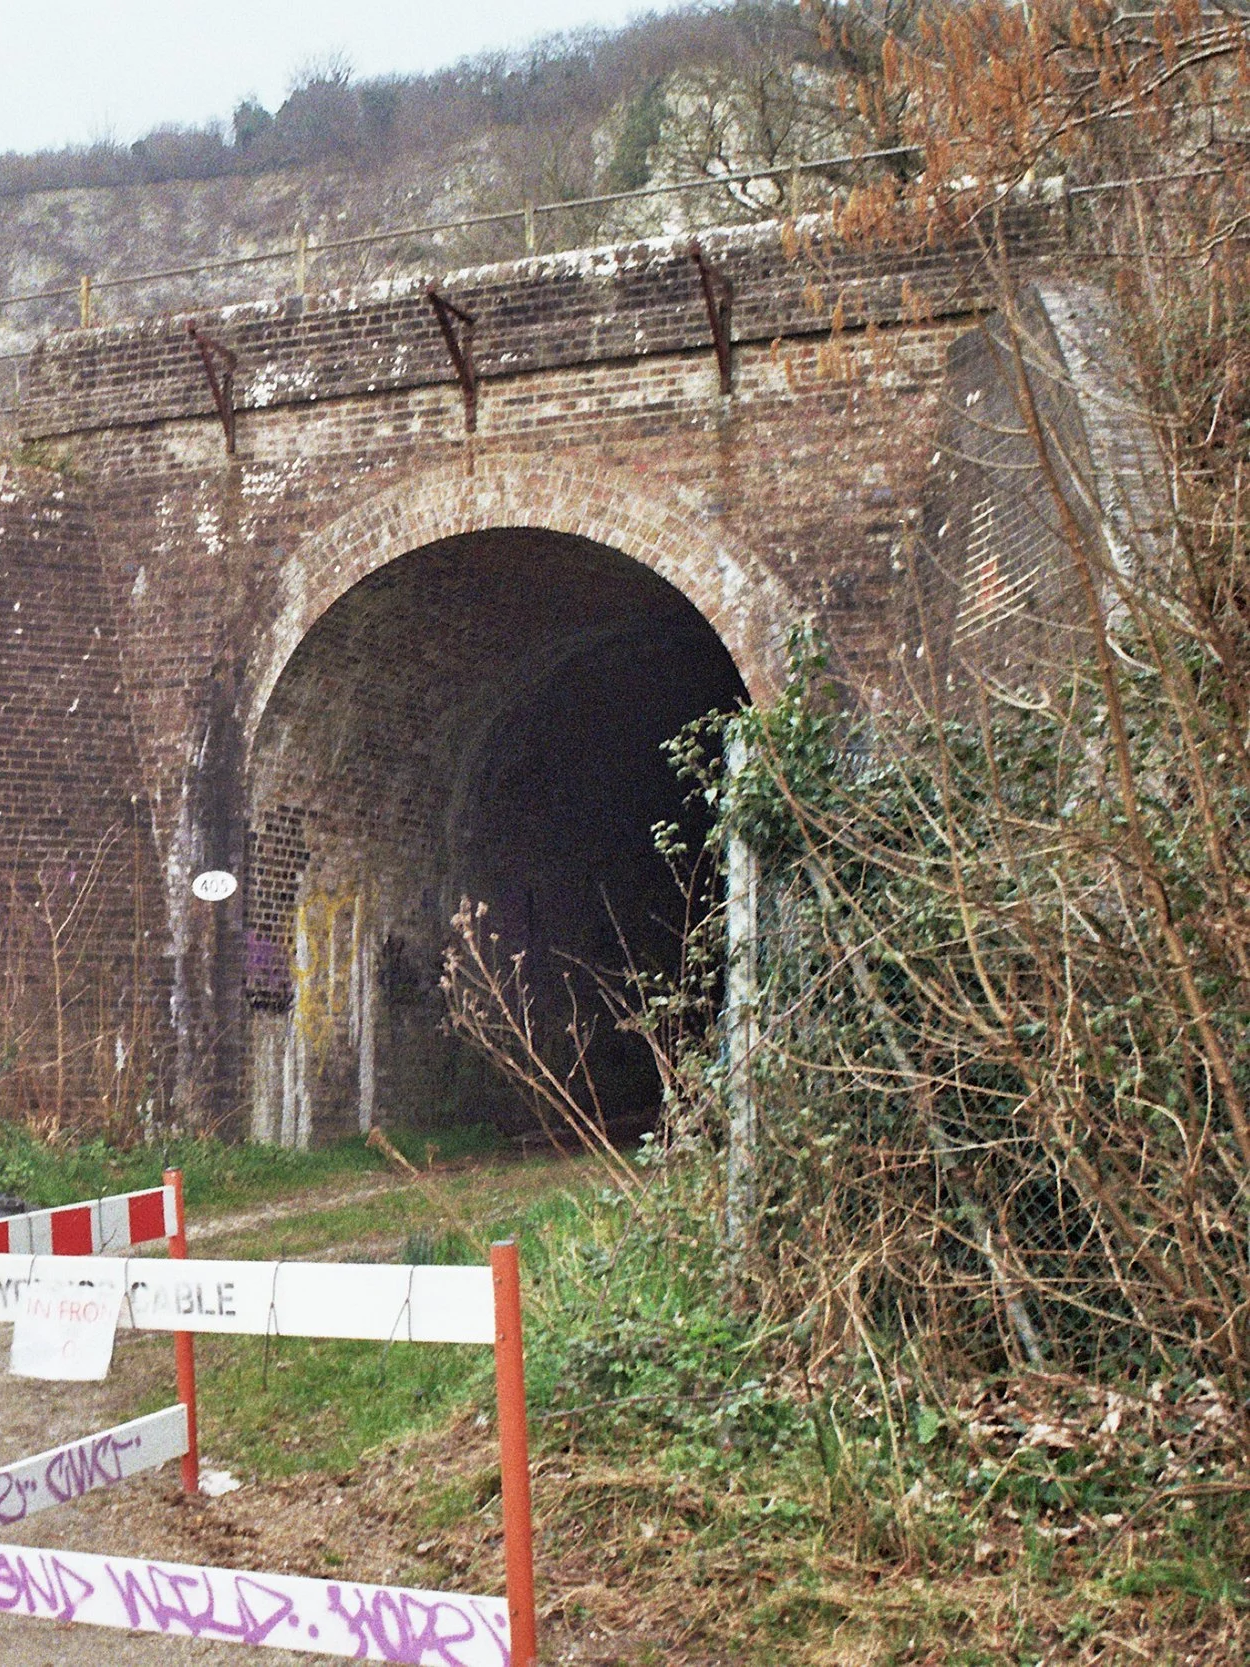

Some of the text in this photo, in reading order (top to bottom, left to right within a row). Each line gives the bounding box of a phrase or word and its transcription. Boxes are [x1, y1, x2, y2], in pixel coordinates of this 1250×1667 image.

[199, 878, 229, 893] 405
[26, 1297, 51, 1320] IN
[130, 1280, 237, 1316] CABLE
